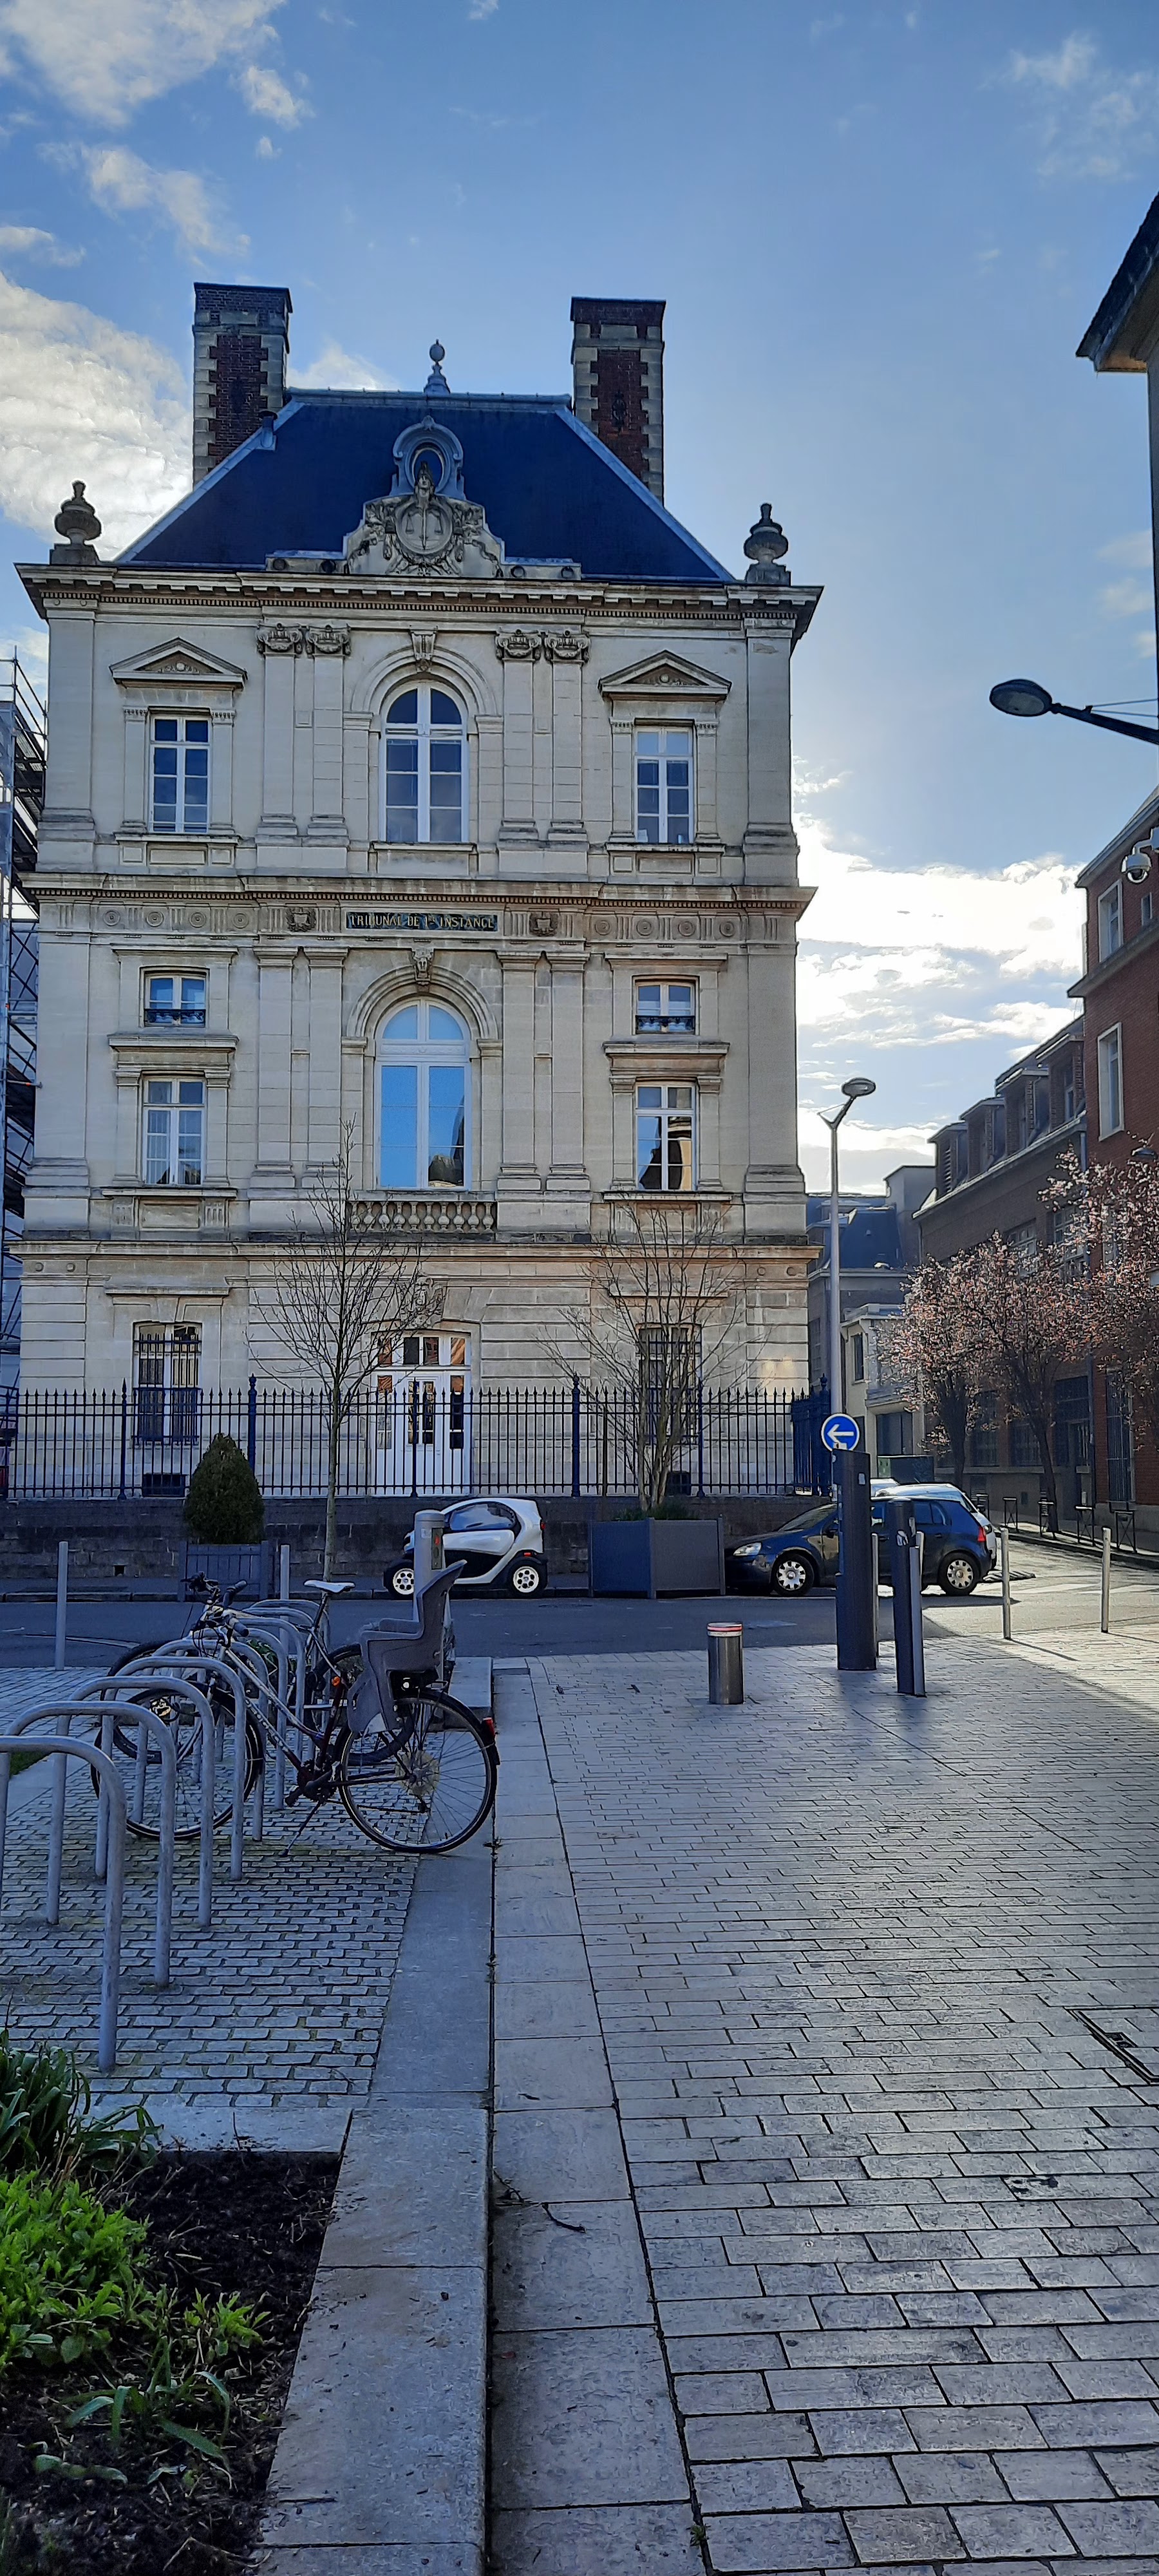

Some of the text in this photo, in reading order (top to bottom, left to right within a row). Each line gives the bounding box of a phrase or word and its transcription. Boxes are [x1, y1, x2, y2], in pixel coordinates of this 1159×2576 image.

[350, 914, 402, 926] TRIBUNAL
[407, 915, 420, 927] DE
[440, 916, 494, 929] INSTANCE
